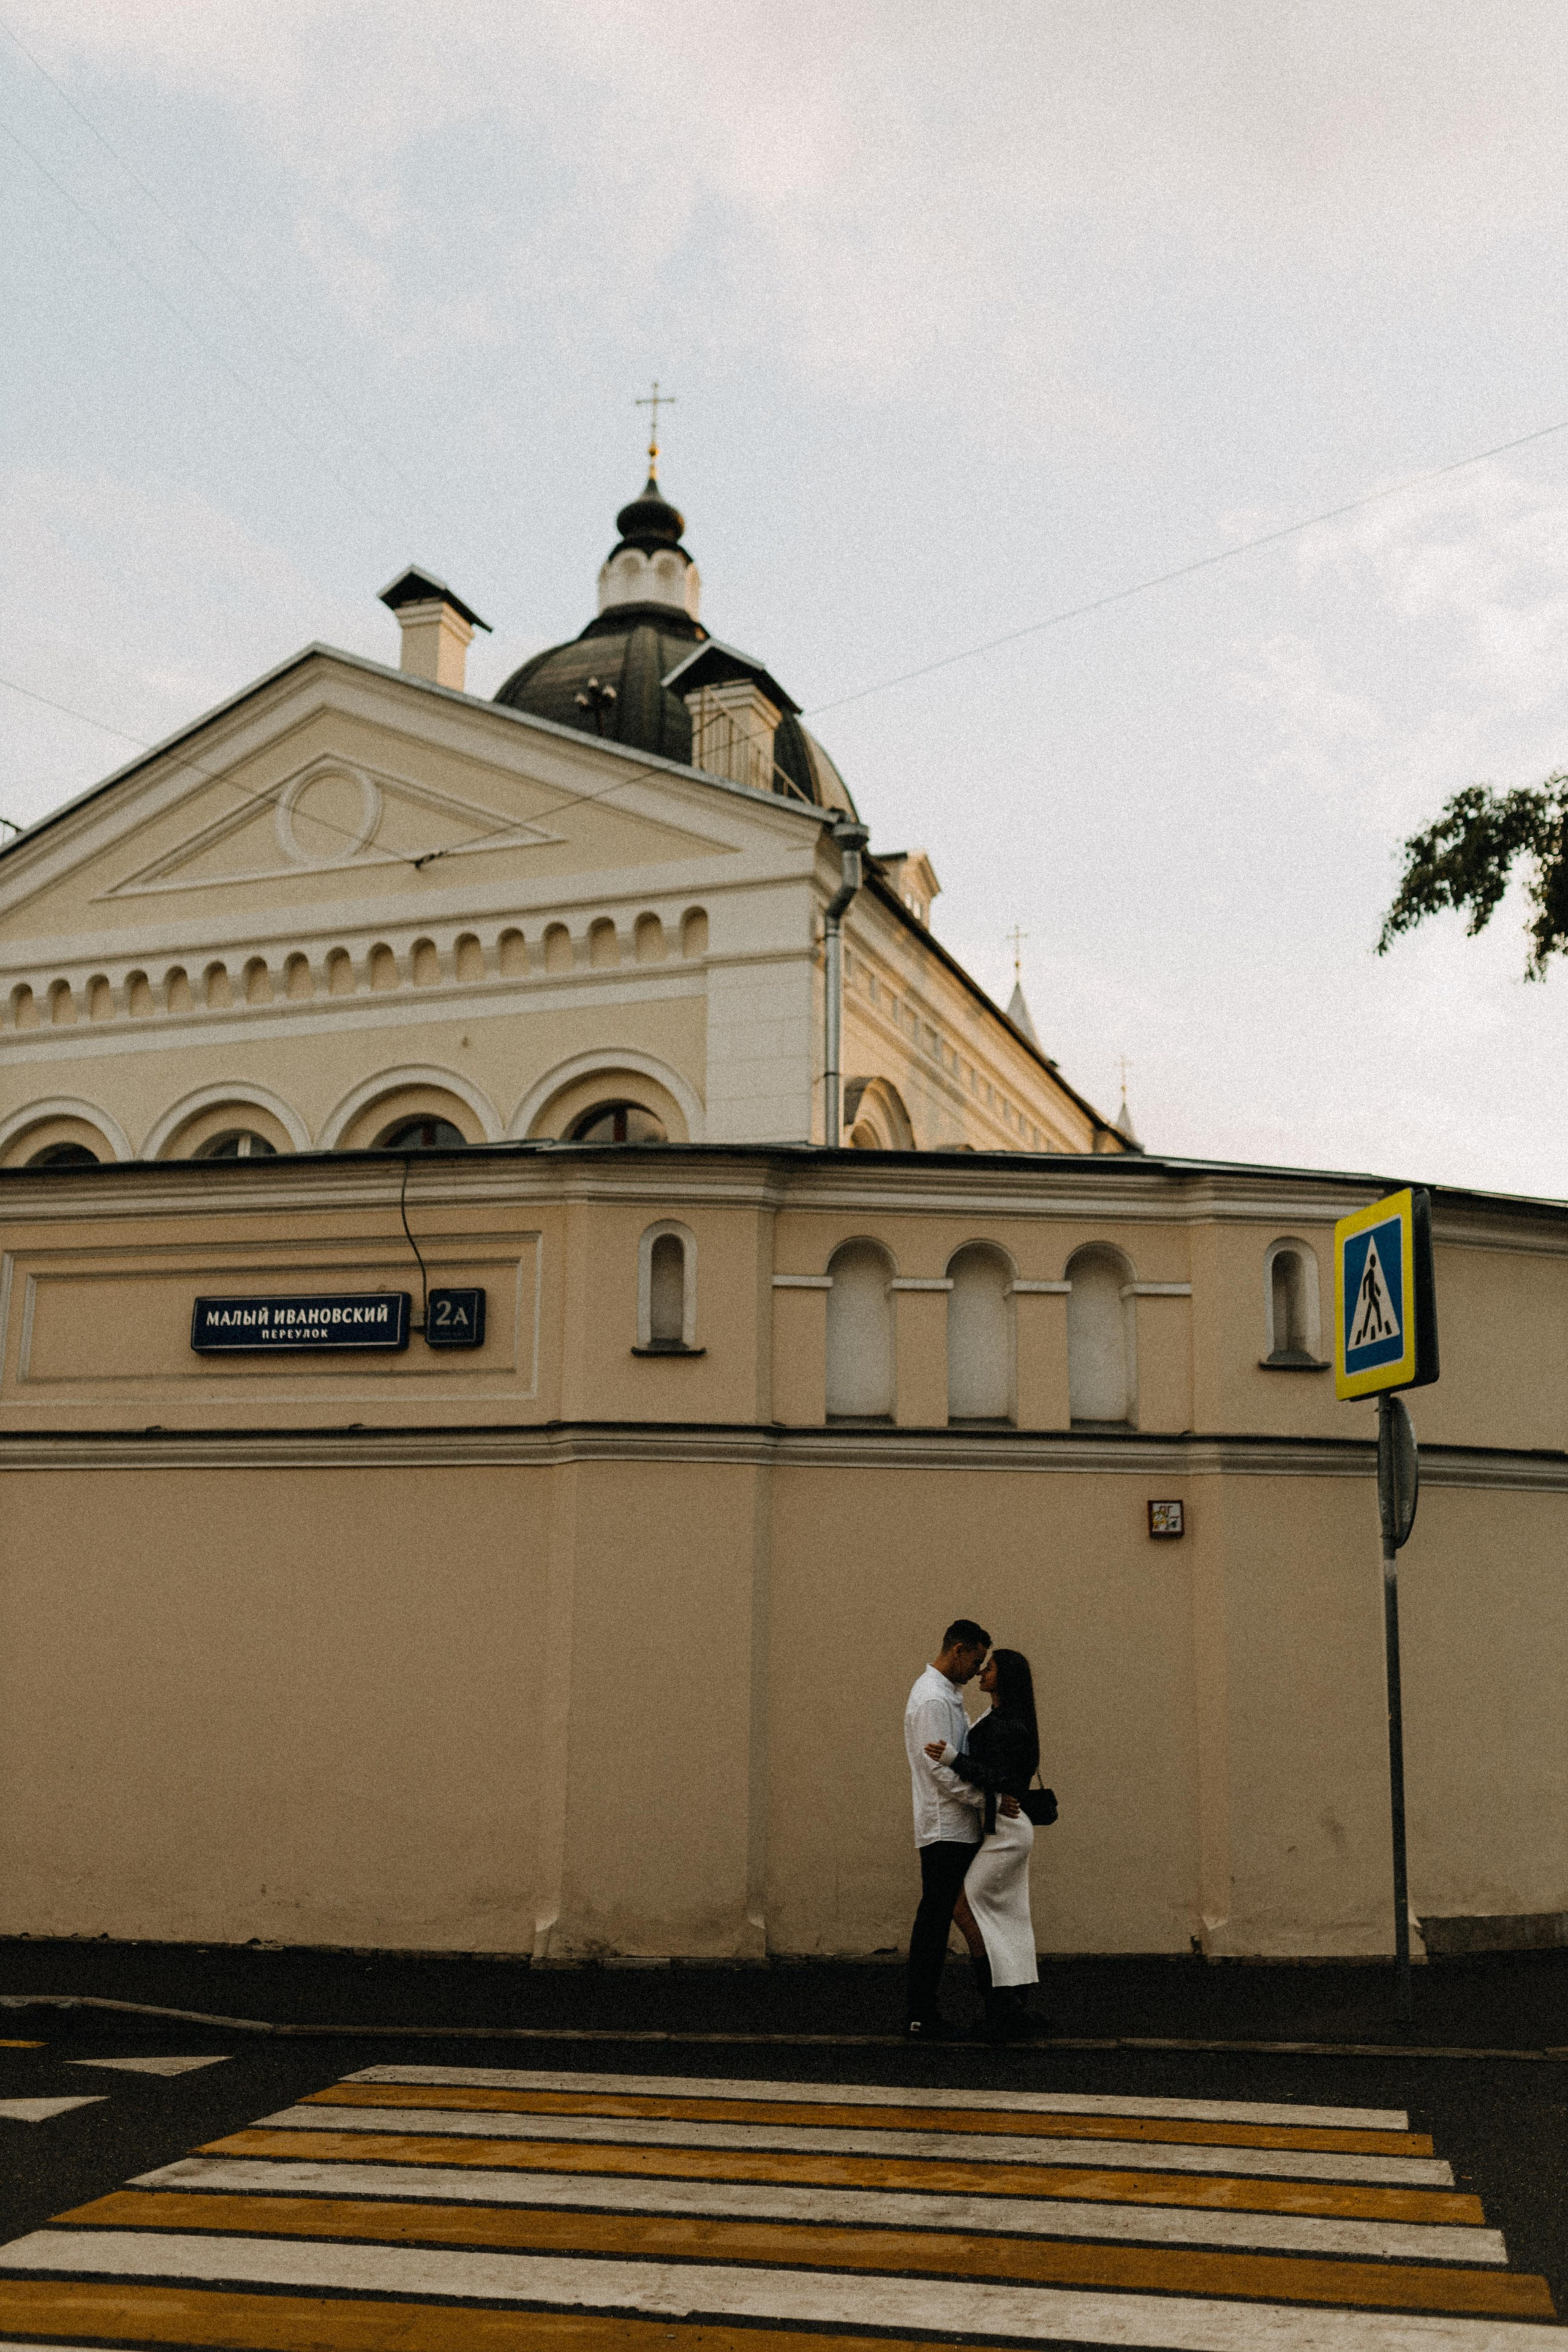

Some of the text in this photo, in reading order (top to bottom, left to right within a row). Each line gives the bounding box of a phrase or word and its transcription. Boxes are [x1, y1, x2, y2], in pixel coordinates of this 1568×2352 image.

[206, 1303, 389, 1327] МАЛЫЙ ИВАНОВСКИЙ
[435, 1300, 469, 1325] 2А
[262, 1328, 329, 1340] ПЕРЕУЛОК
